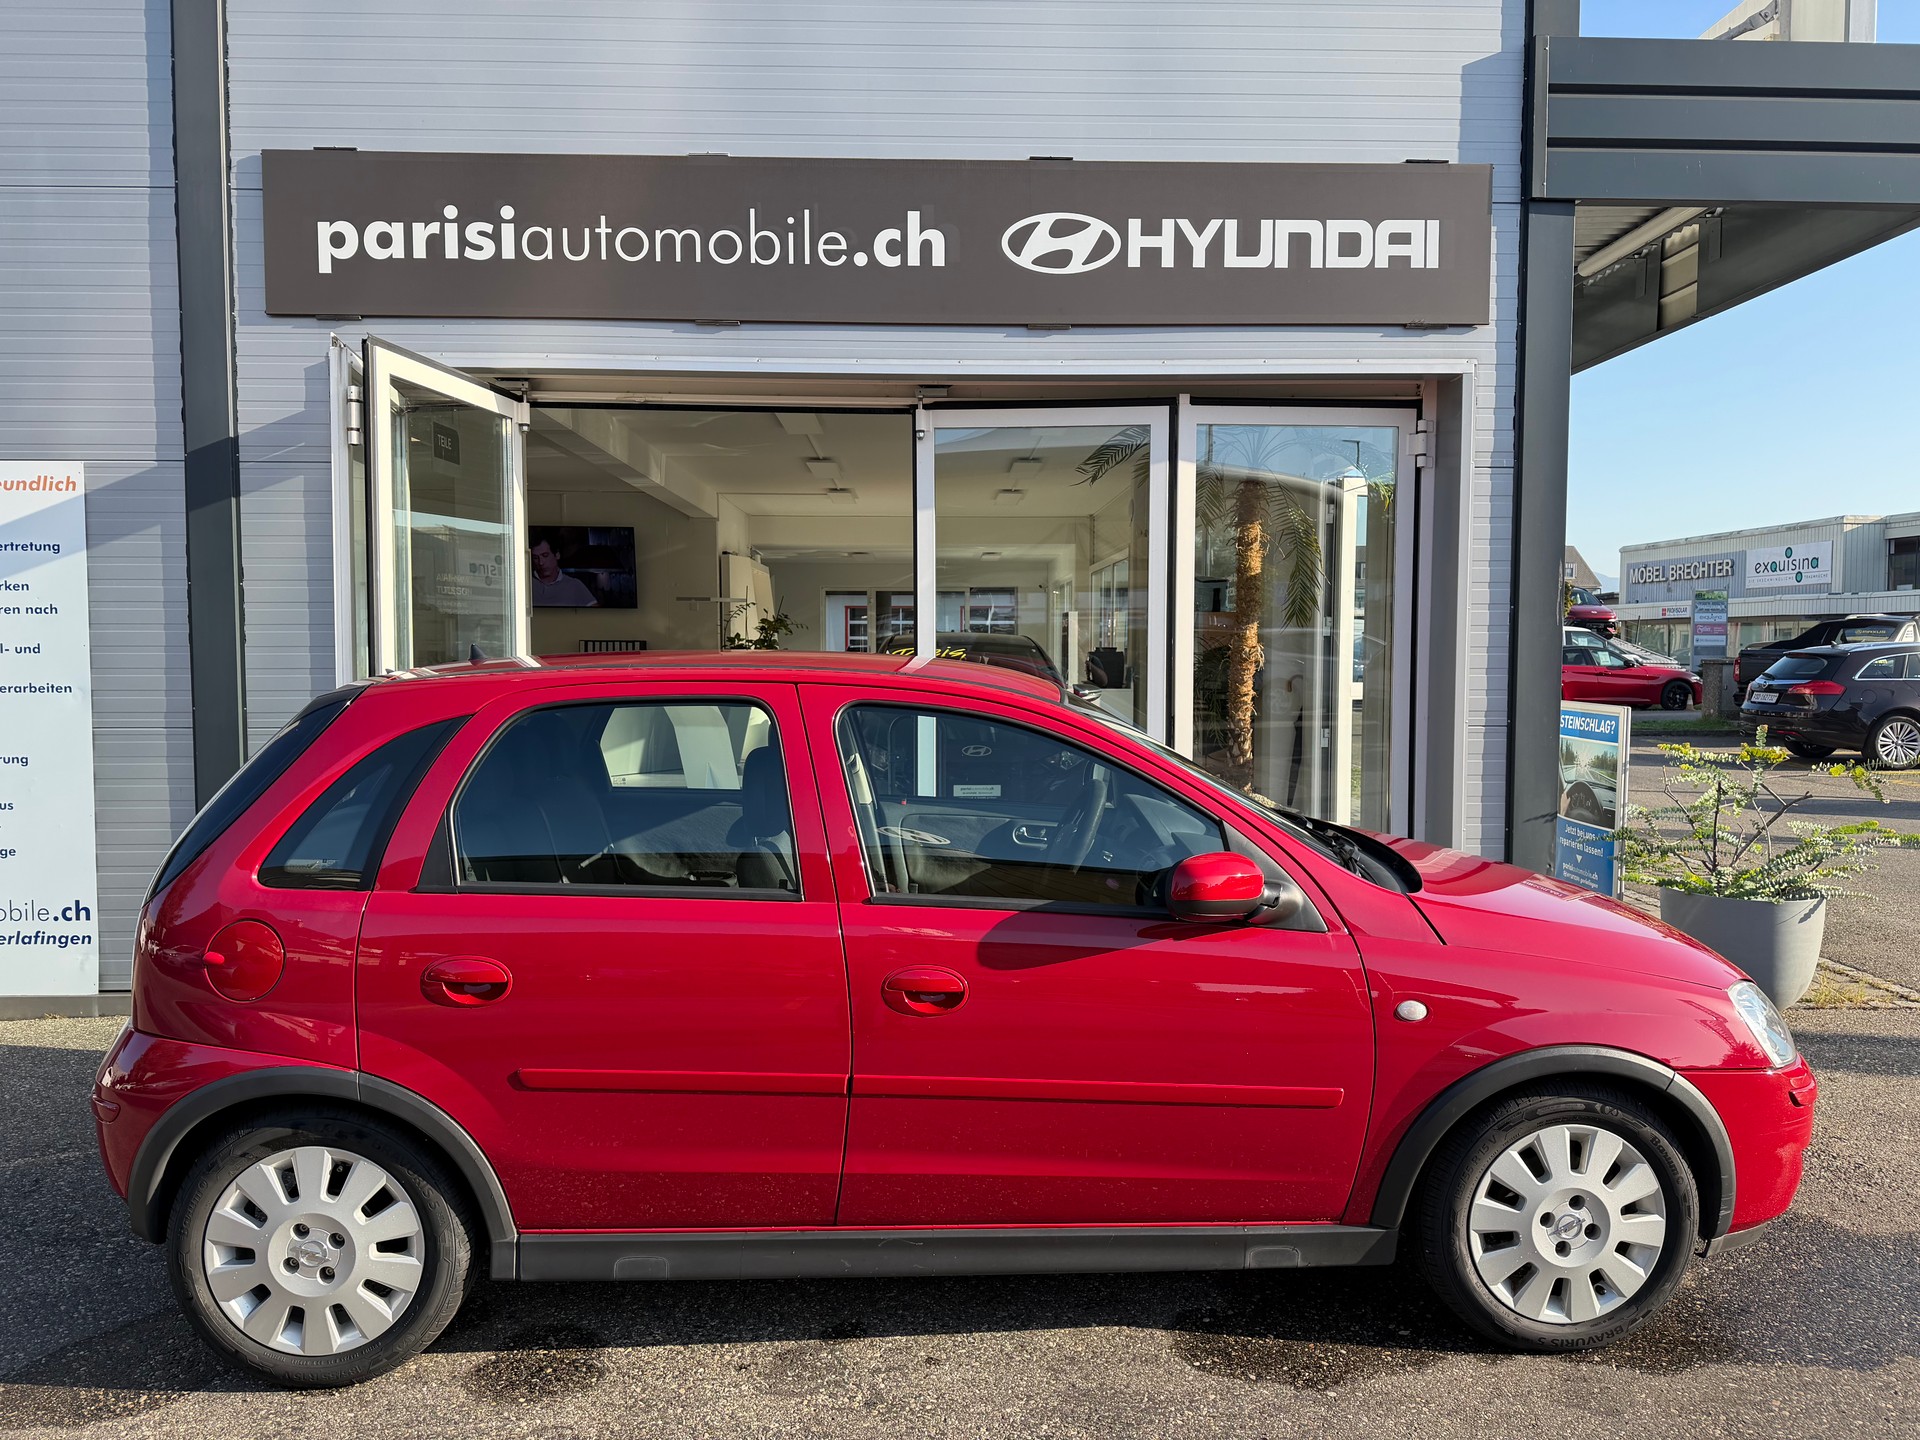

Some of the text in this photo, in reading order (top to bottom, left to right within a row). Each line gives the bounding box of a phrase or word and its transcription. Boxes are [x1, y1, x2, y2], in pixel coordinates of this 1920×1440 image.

[317, 204, 945, 274] parisiautomobile.ch
[1128, 218, 1439, 269] HYUNDAI
[0, 475, 77, 492] undlich
[1629, 559, 1733, 584] MÖBEL BRECHTER
[25, 604, 58, 615] nach
[15, 643, 40, 654] und
[0, 683, 72, 694] erarbeiten
[1560, 715, 1616, 735] STEINSCHLAG?
[1551, 1325, 1624, 1347] BRAVURIS
